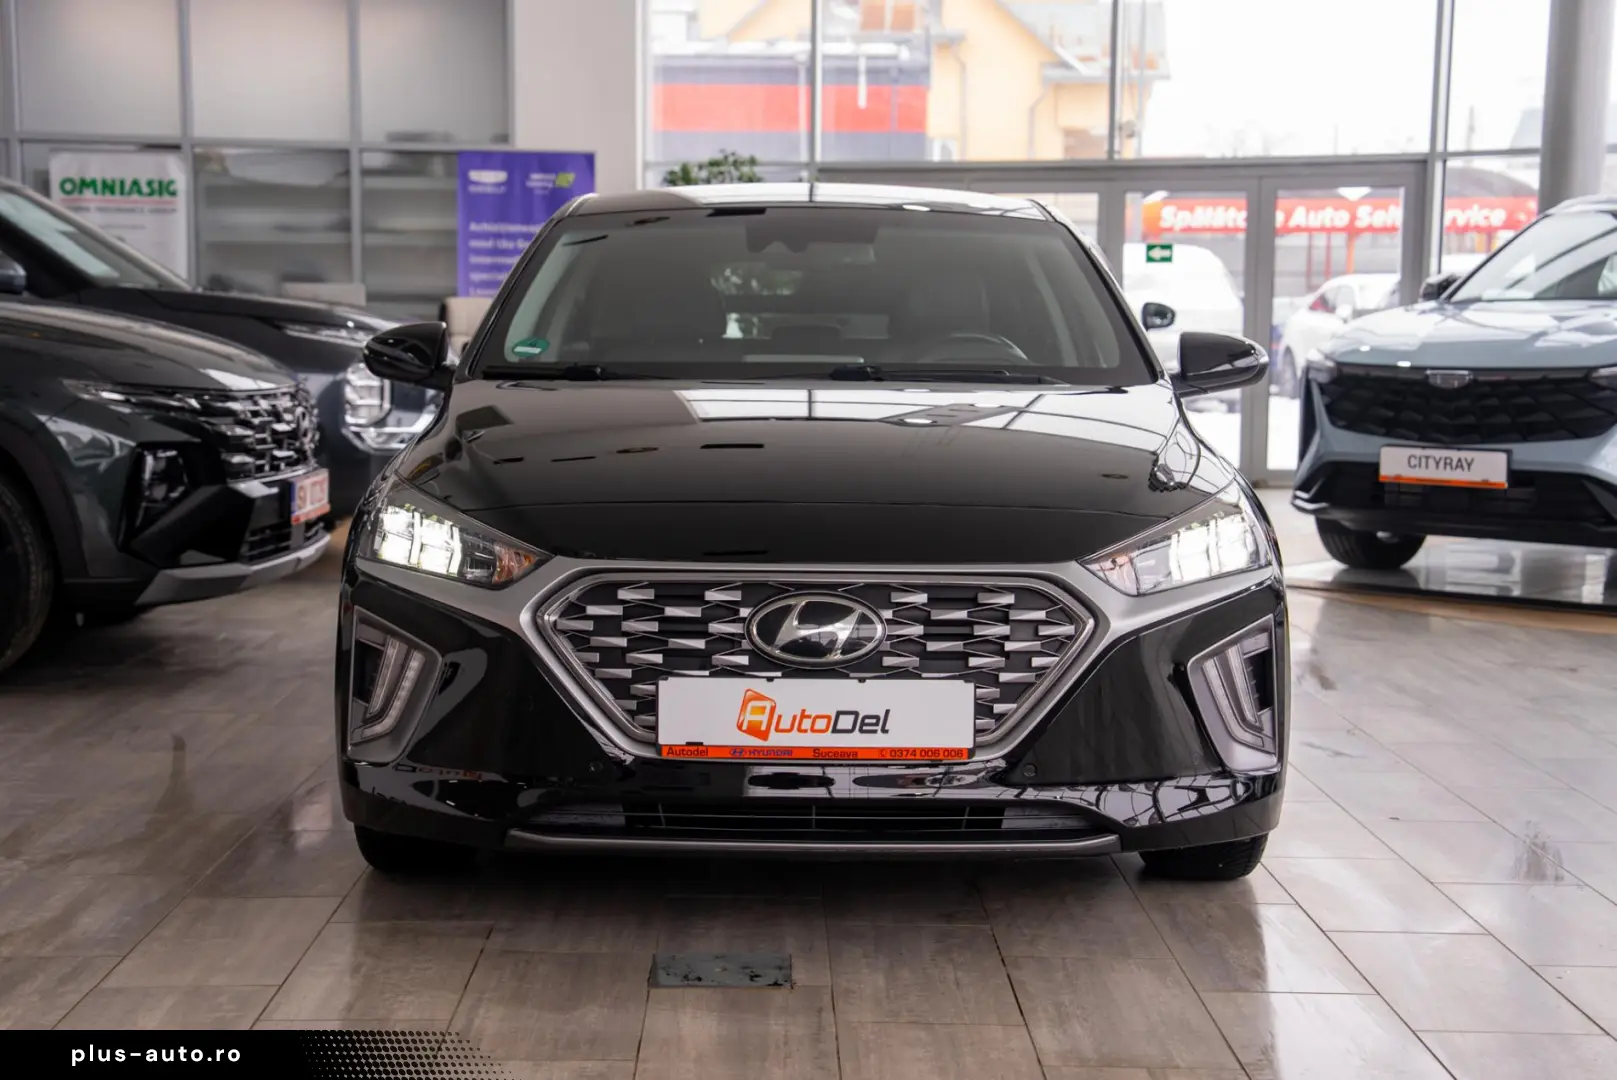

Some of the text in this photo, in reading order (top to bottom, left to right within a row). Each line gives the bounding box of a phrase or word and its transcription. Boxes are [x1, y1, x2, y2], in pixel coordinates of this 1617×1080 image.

[59, 177, 178, 197] OMNIASIG
[1288, 206, 1350, 228] Auto
[1407, 454, 1474, 472] CITYRAY
[737, 689, 890, 741] AutoDel
[666, 747, 708, 756] Autodel
[812, 749, 858, 758] Suceava
[889, 748, 917, 758] 0374
[919, 748, 941, 758] 006
[942, 748, 964, 758] 006
